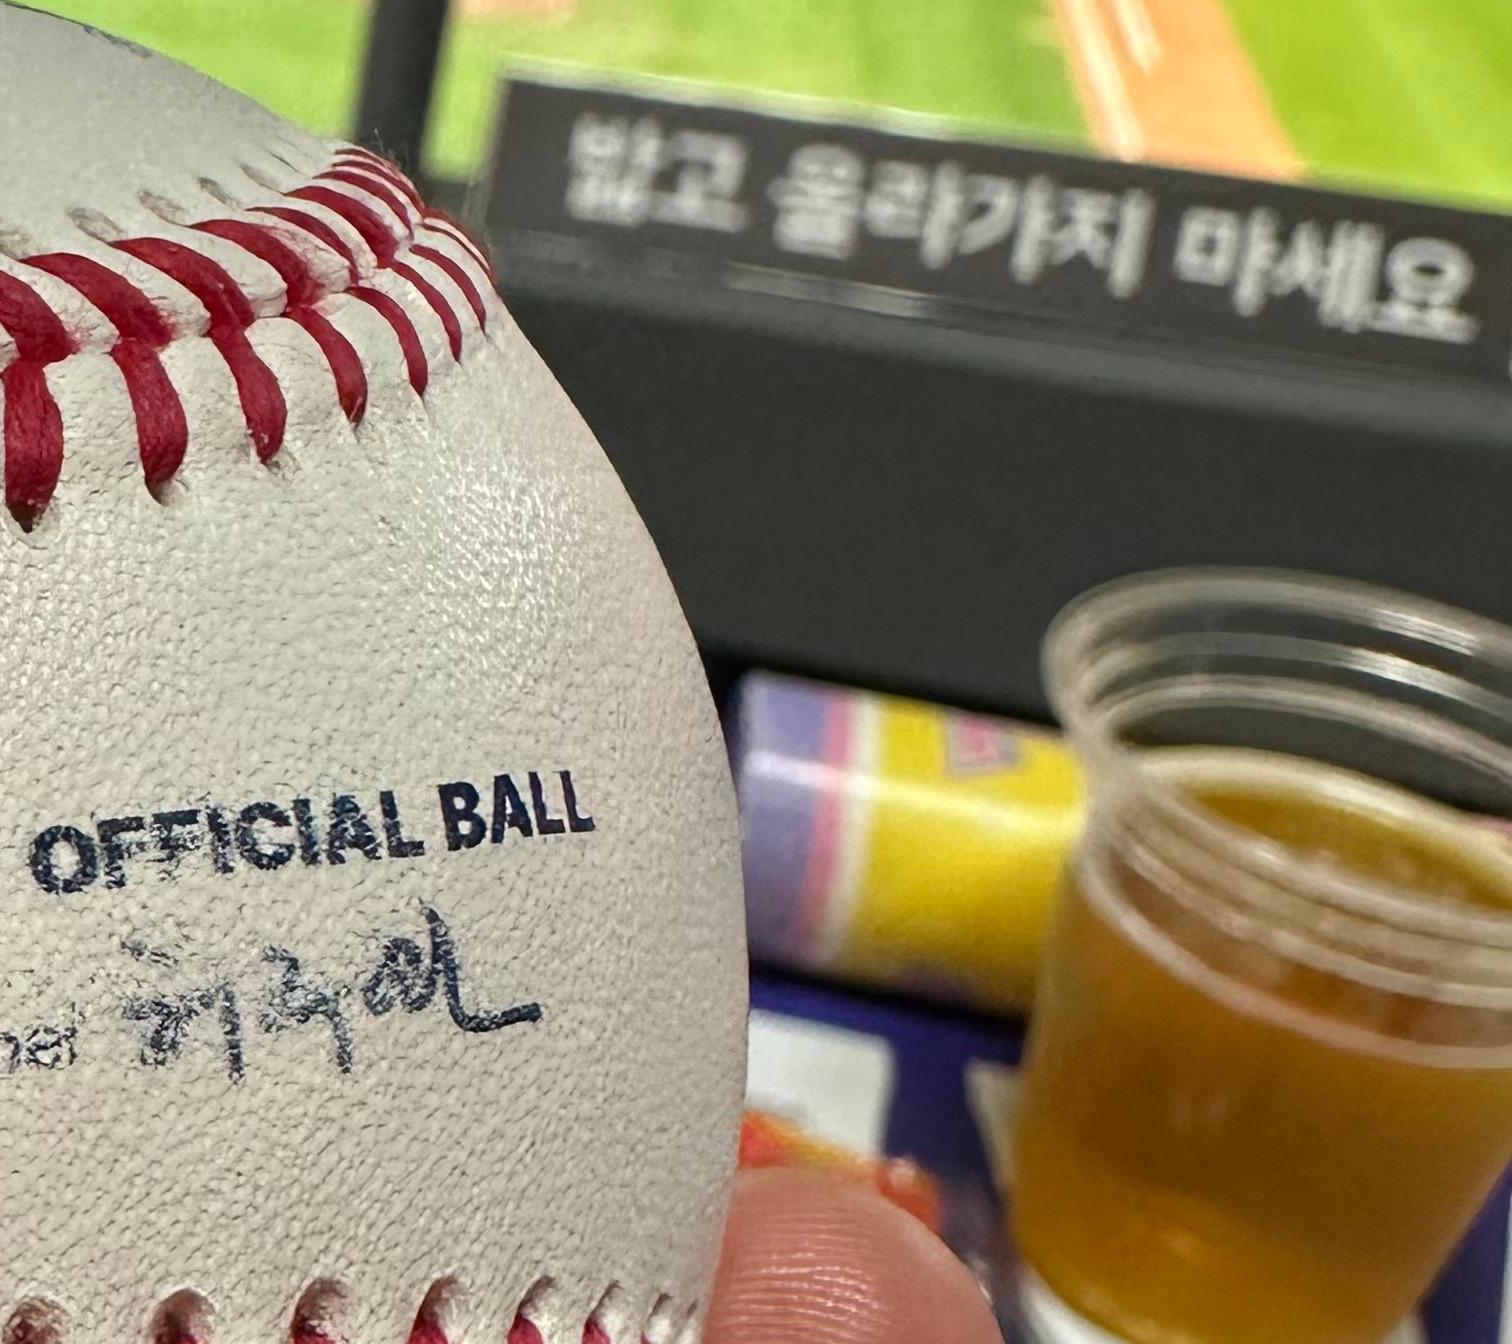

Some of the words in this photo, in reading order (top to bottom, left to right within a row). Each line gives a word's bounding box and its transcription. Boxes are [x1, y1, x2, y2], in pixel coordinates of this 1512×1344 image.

[767, 142, 1155, 299] 올라가지
[1173, 206, 1481, 345] 마세요
[29, 790, 425, 894] OFFICIAL
[438, 769, 595, 852] BALL
